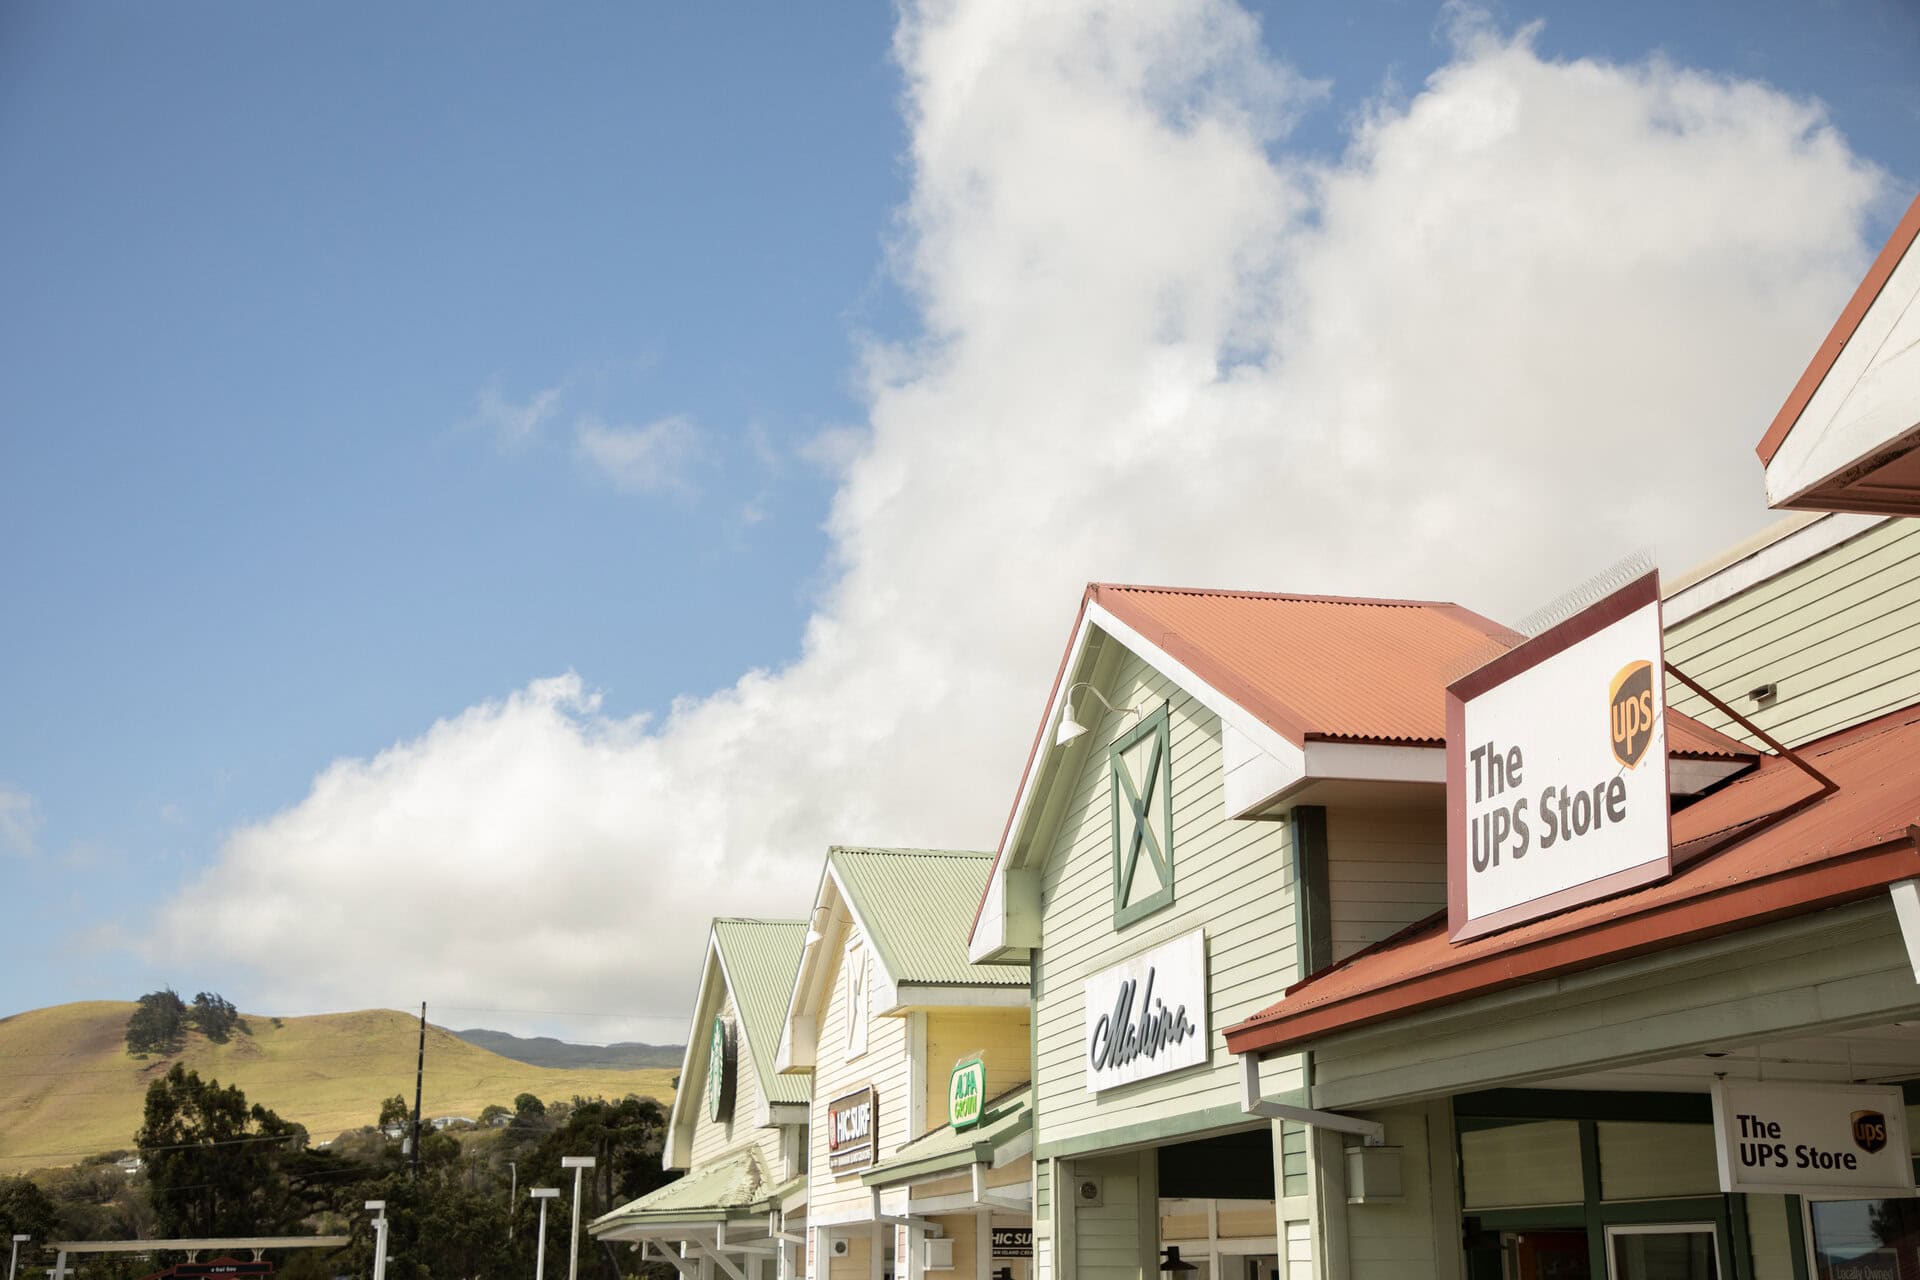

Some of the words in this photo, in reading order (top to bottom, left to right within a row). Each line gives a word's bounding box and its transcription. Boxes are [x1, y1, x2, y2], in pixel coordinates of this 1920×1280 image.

[1612, 690, 1652, 756] ups
[1470, 741, 1523, 804] The
[1471, 797, 1530, 873] UPS
[1539, 776, 1627, 849] Store
[1091, 966, 1195, 1073] Mahina
[837, 1109, 852, 1144] HIC
[851, 1102, 871, 1140] SURF
[1736, 1114, 1781, 1139] The
[1855, 1122, 1885, 1148] ups
[1740, 1143, 1789, 1168] UPS
[1795, 1144, 1857, 1170] Store
[1014, 1233, 1033, 1245] SU
